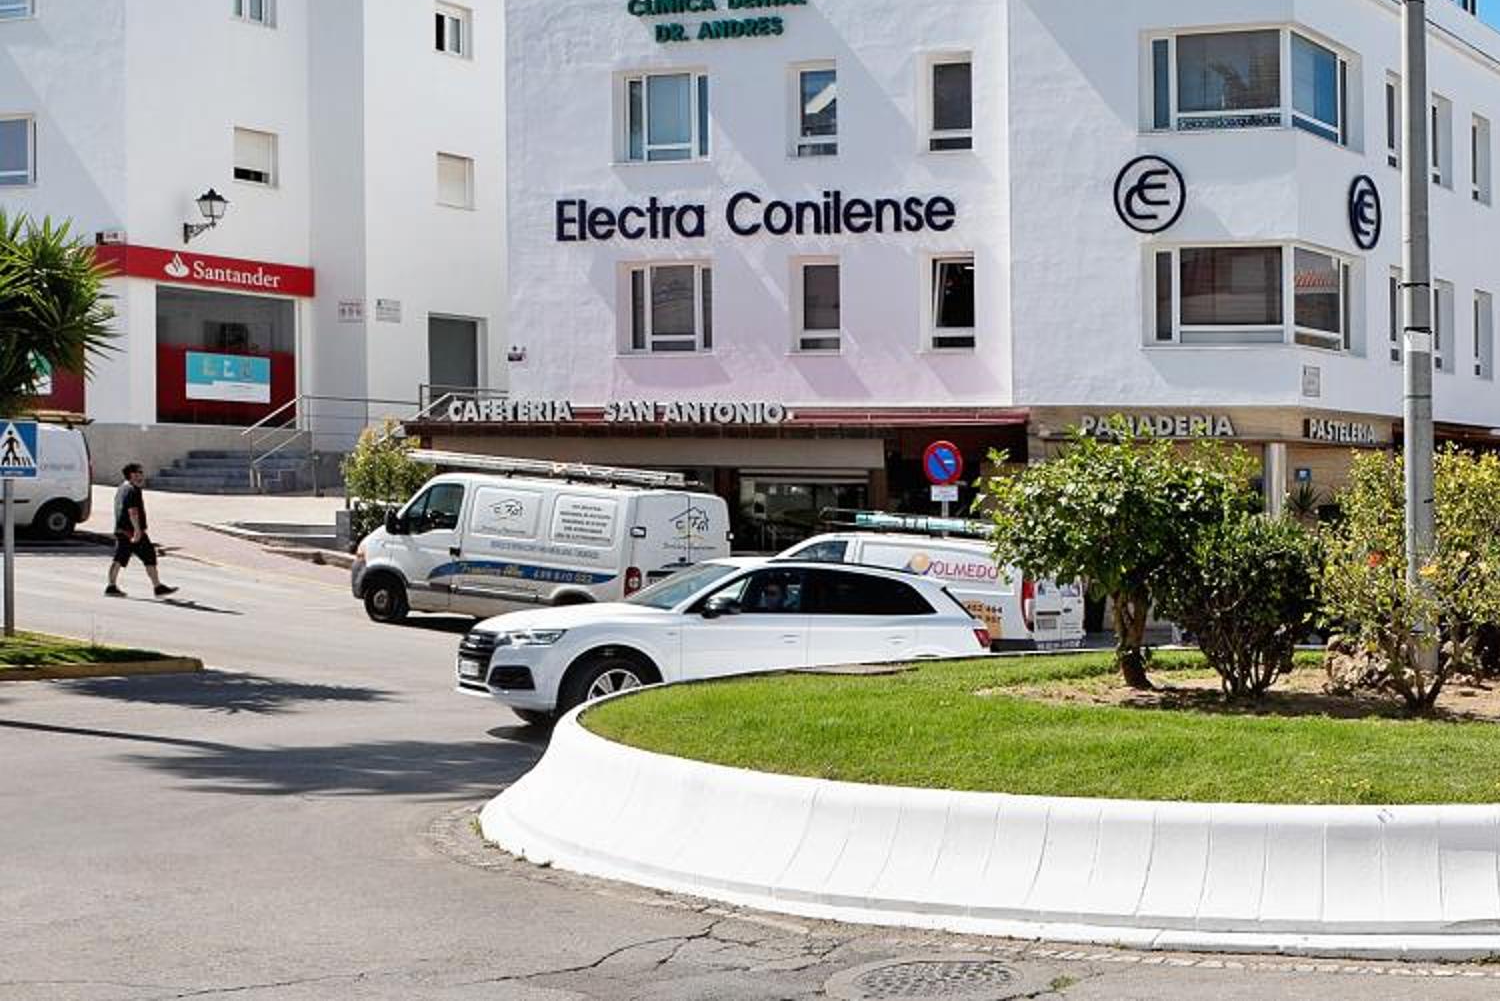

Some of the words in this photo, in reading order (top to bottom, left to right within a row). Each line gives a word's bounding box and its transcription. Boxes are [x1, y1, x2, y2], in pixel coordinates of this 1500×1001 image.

[655, 23, 690, 44] DR.
[697, 17, 784, 40] ANDRES
[555, 196, 706, 242] Electra
[725, 190, 957, 236] Conilense
[193, 261, 280, 288] Santander
[449, 399, 573, 422] CAFETERIA
[604, 401, 656, 423] SAN
[1309, 418, 1377, 444] PASTELERIA
